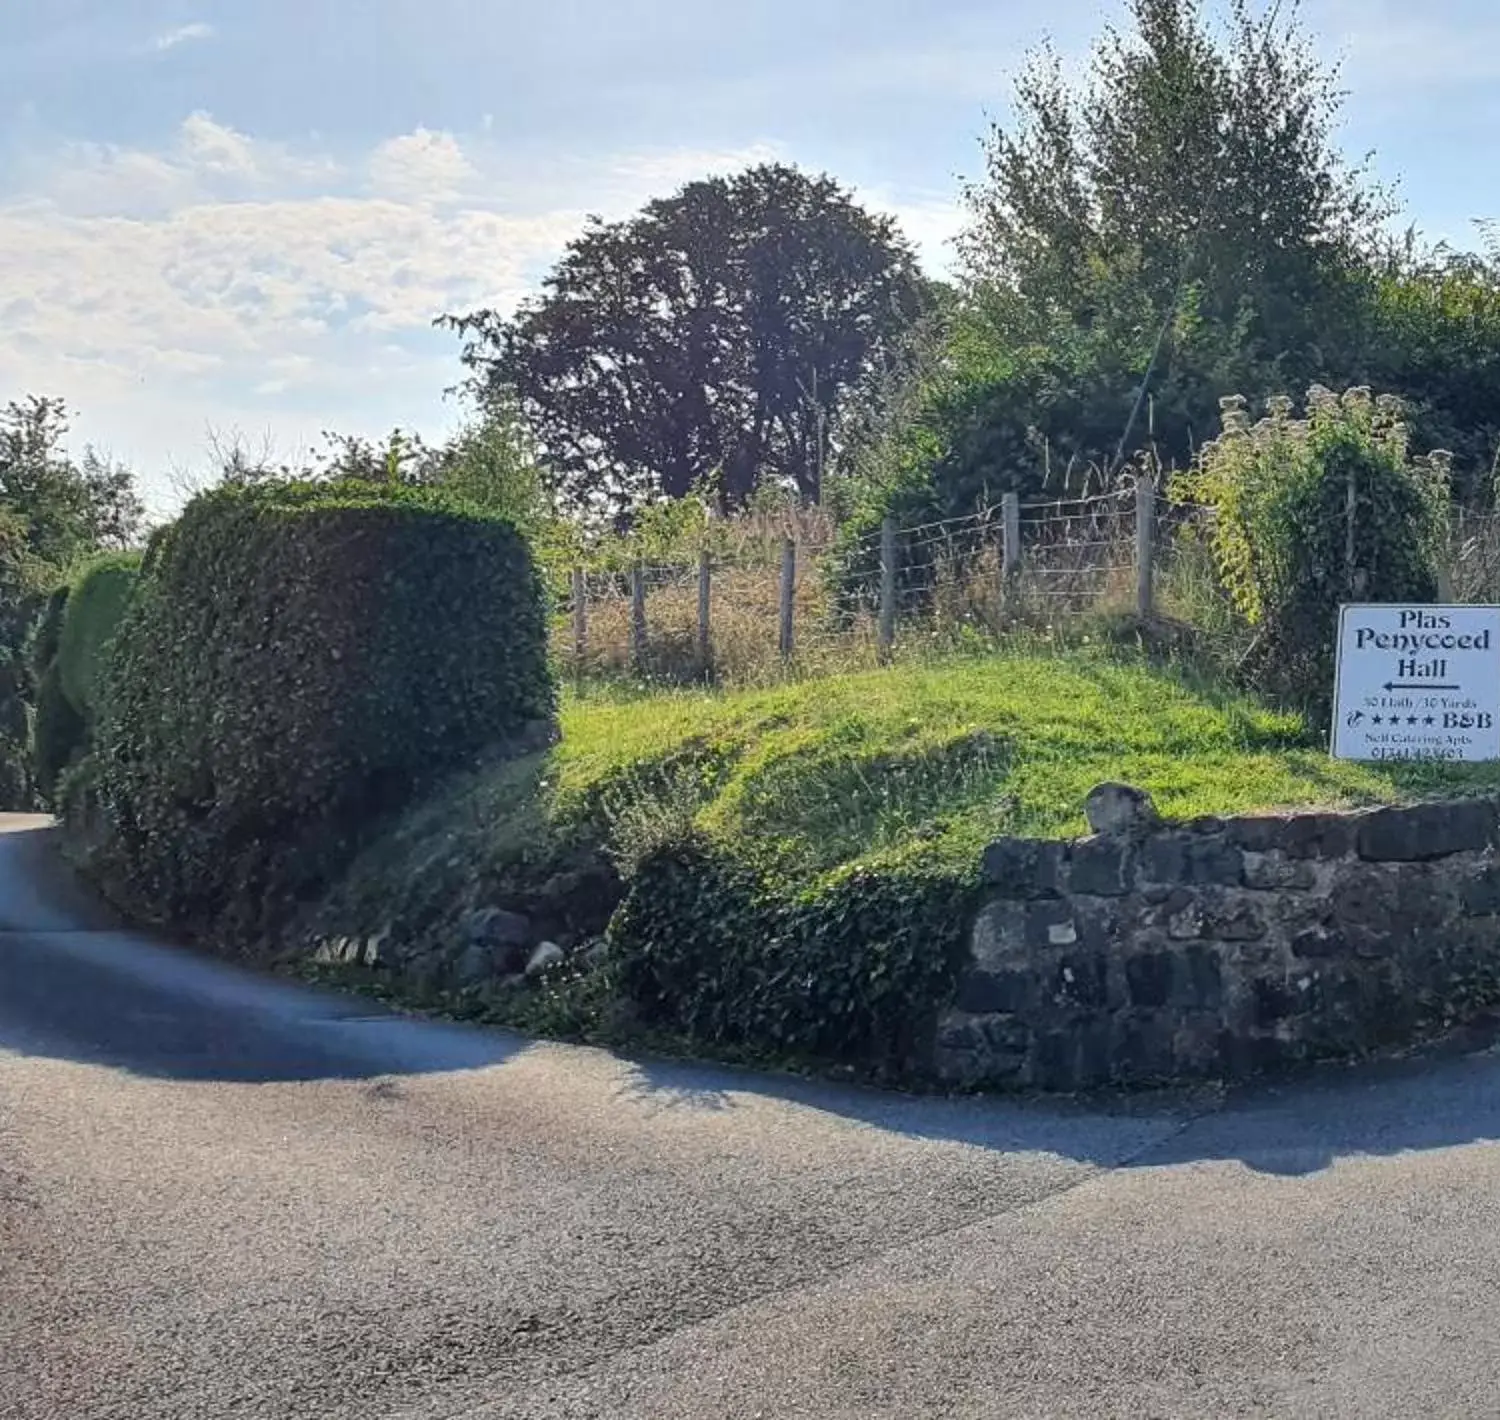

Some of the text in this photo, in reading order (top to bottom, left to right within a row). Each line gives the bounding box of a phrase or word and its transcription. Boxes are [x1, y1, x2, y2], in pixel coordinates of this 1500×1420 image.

[1399, 610, 1451, 629] Plas
[1355, 628, 1490, 656] Penycoed
[1397, 658, 1448, 678] Hall
[1441, 697, 1477, 709] Yards
[1443, 711, 1493, 729] B&B
[1391, 733, 1442, 746] Catering
